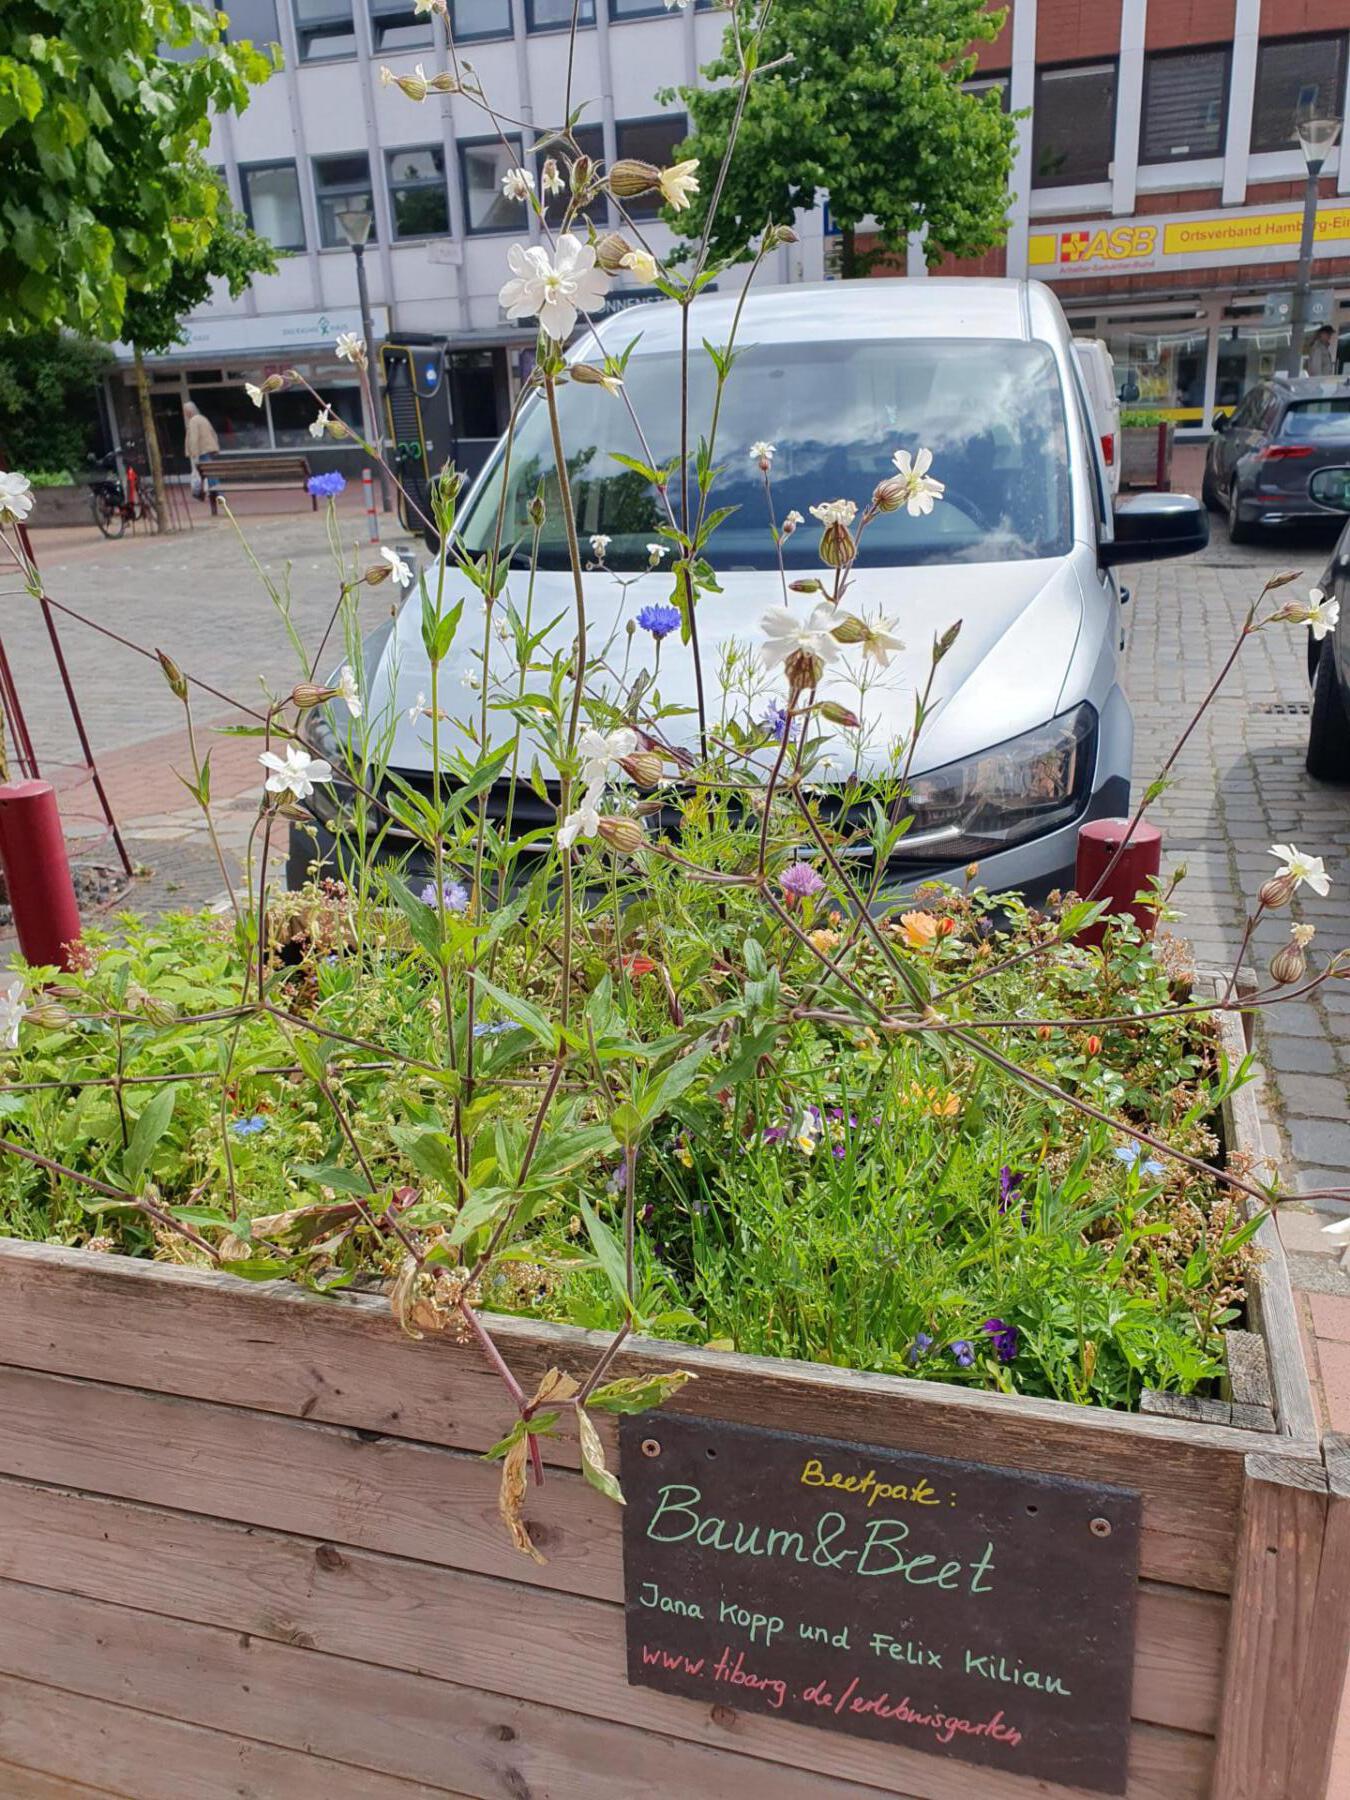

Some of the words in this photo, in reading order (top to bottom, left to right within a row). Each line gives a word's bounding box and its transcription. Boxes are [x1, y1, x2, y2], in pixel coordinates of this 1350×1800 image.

[1084, 225, 1157, 262] ASB
[1180, 224, 1262, 242] Ortsverband
[1265, 214, 1350, 235] Hambg-Ei
[639, 1582, 704, 1620] Jana
[719, 1600, 784, 1647] Kopp
[800, 1623, 850, 1650] und
[869, 1632, 943, 1670] Felix
[965, 1649, 1071, 1695] Kilian
